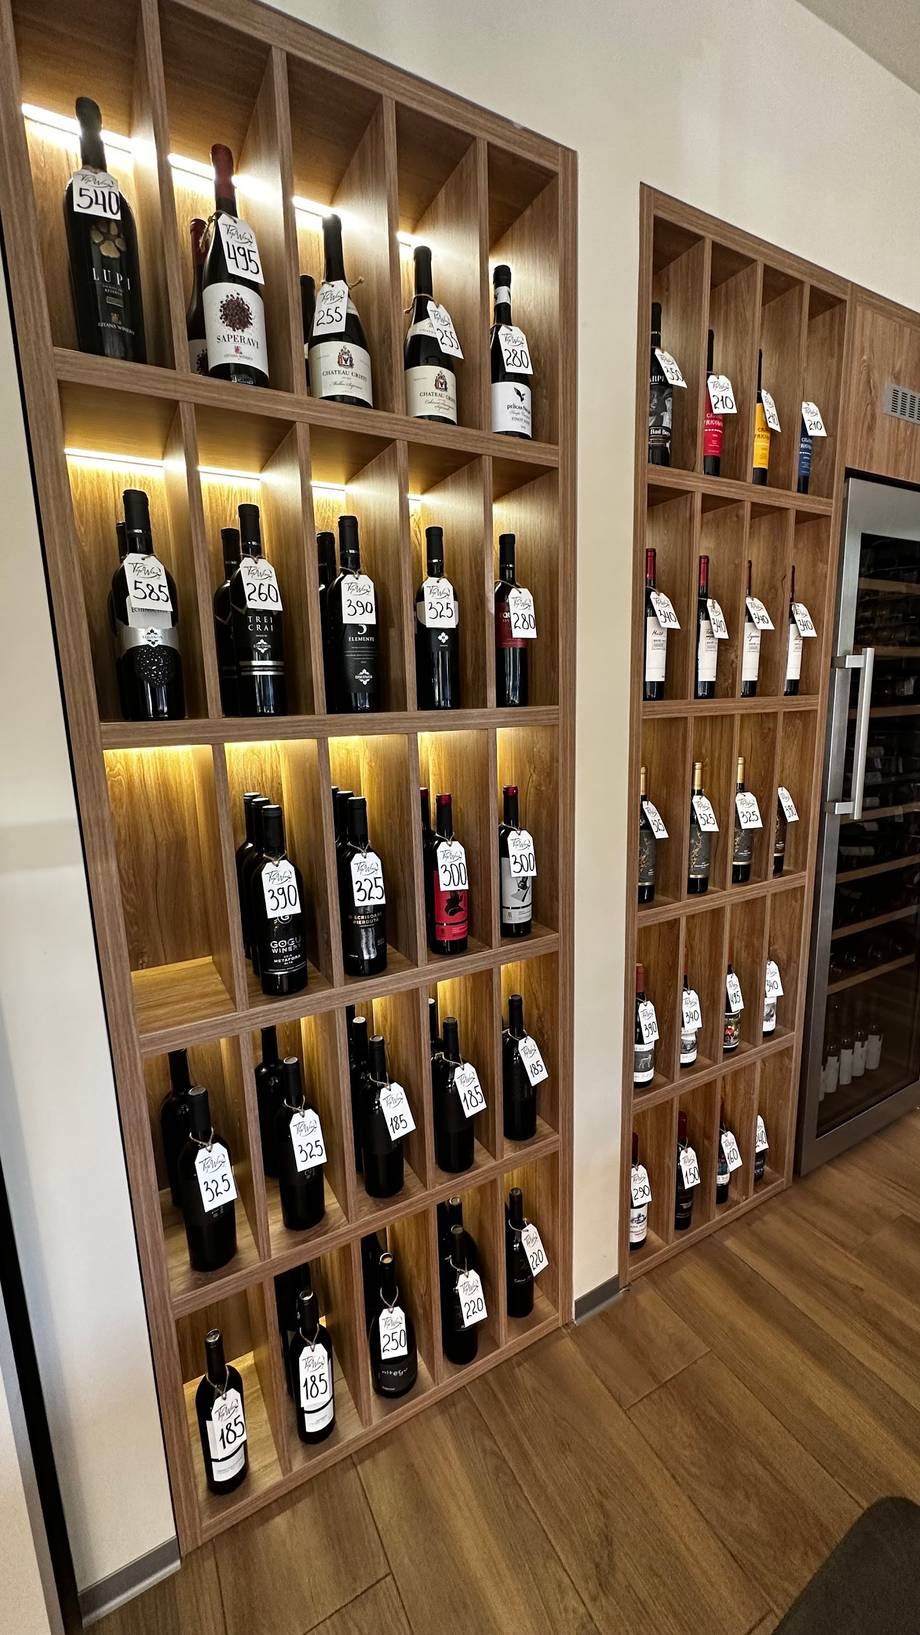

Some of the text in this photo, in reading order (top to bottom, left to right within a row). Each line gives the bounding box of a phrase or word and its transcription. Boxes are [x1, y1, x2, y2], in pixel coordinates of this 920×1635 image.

[77, 187, 120, 215] 540
[226, 241, 260, 275] 495
[92, 267, 131, 291] LUPI
[316, 306, 343, 326] 255
[216, 335, 260, 349] SAPERAVI
[436, 328, 460, 350] 255
[504, 348, 530, 368] 280
[712, 394, 734, 410] 210
[133, 580, 170, 602] 585
[246, 582, 279, 602] 260
[346, 598, 374, 617] 390
[428, 601, 454, 619] 325
[247, 624, 274, 632] CRAI
[248, 615, 274, 624] TREI
[512, 612, 536, 630] 280
[740, 810, 759, 824] 325
[511, 852, 535, 874] 300
[440, 862, 467, 887] 300
[267, 884, 298, 912] 390
[355, 877, 385, 902] 325
[270, 936, 301, 949] GOGU
[685, 1010, 700, 1024] 340
[644, 1021, 658, 1038] 390
[530, 1060, 544, 1078] 185
[462, 1085, 484, 1110] 185
[389, 1114, 408, 1134] 185
[297, 1139, 324, 1163] 325
[684, 1166, 699, 1185] 150
[203, 1173, 231, 1202] 325
[632, 1184, 650, 1201] 290
[529, 1249, 544, 1270] 220
[464, 1297, 484, 1319] 220
[382, 1329, 407, 1353] 250
[303, 1372, 328, 1400] 185
[219, 1415, 245, 1450] 185
